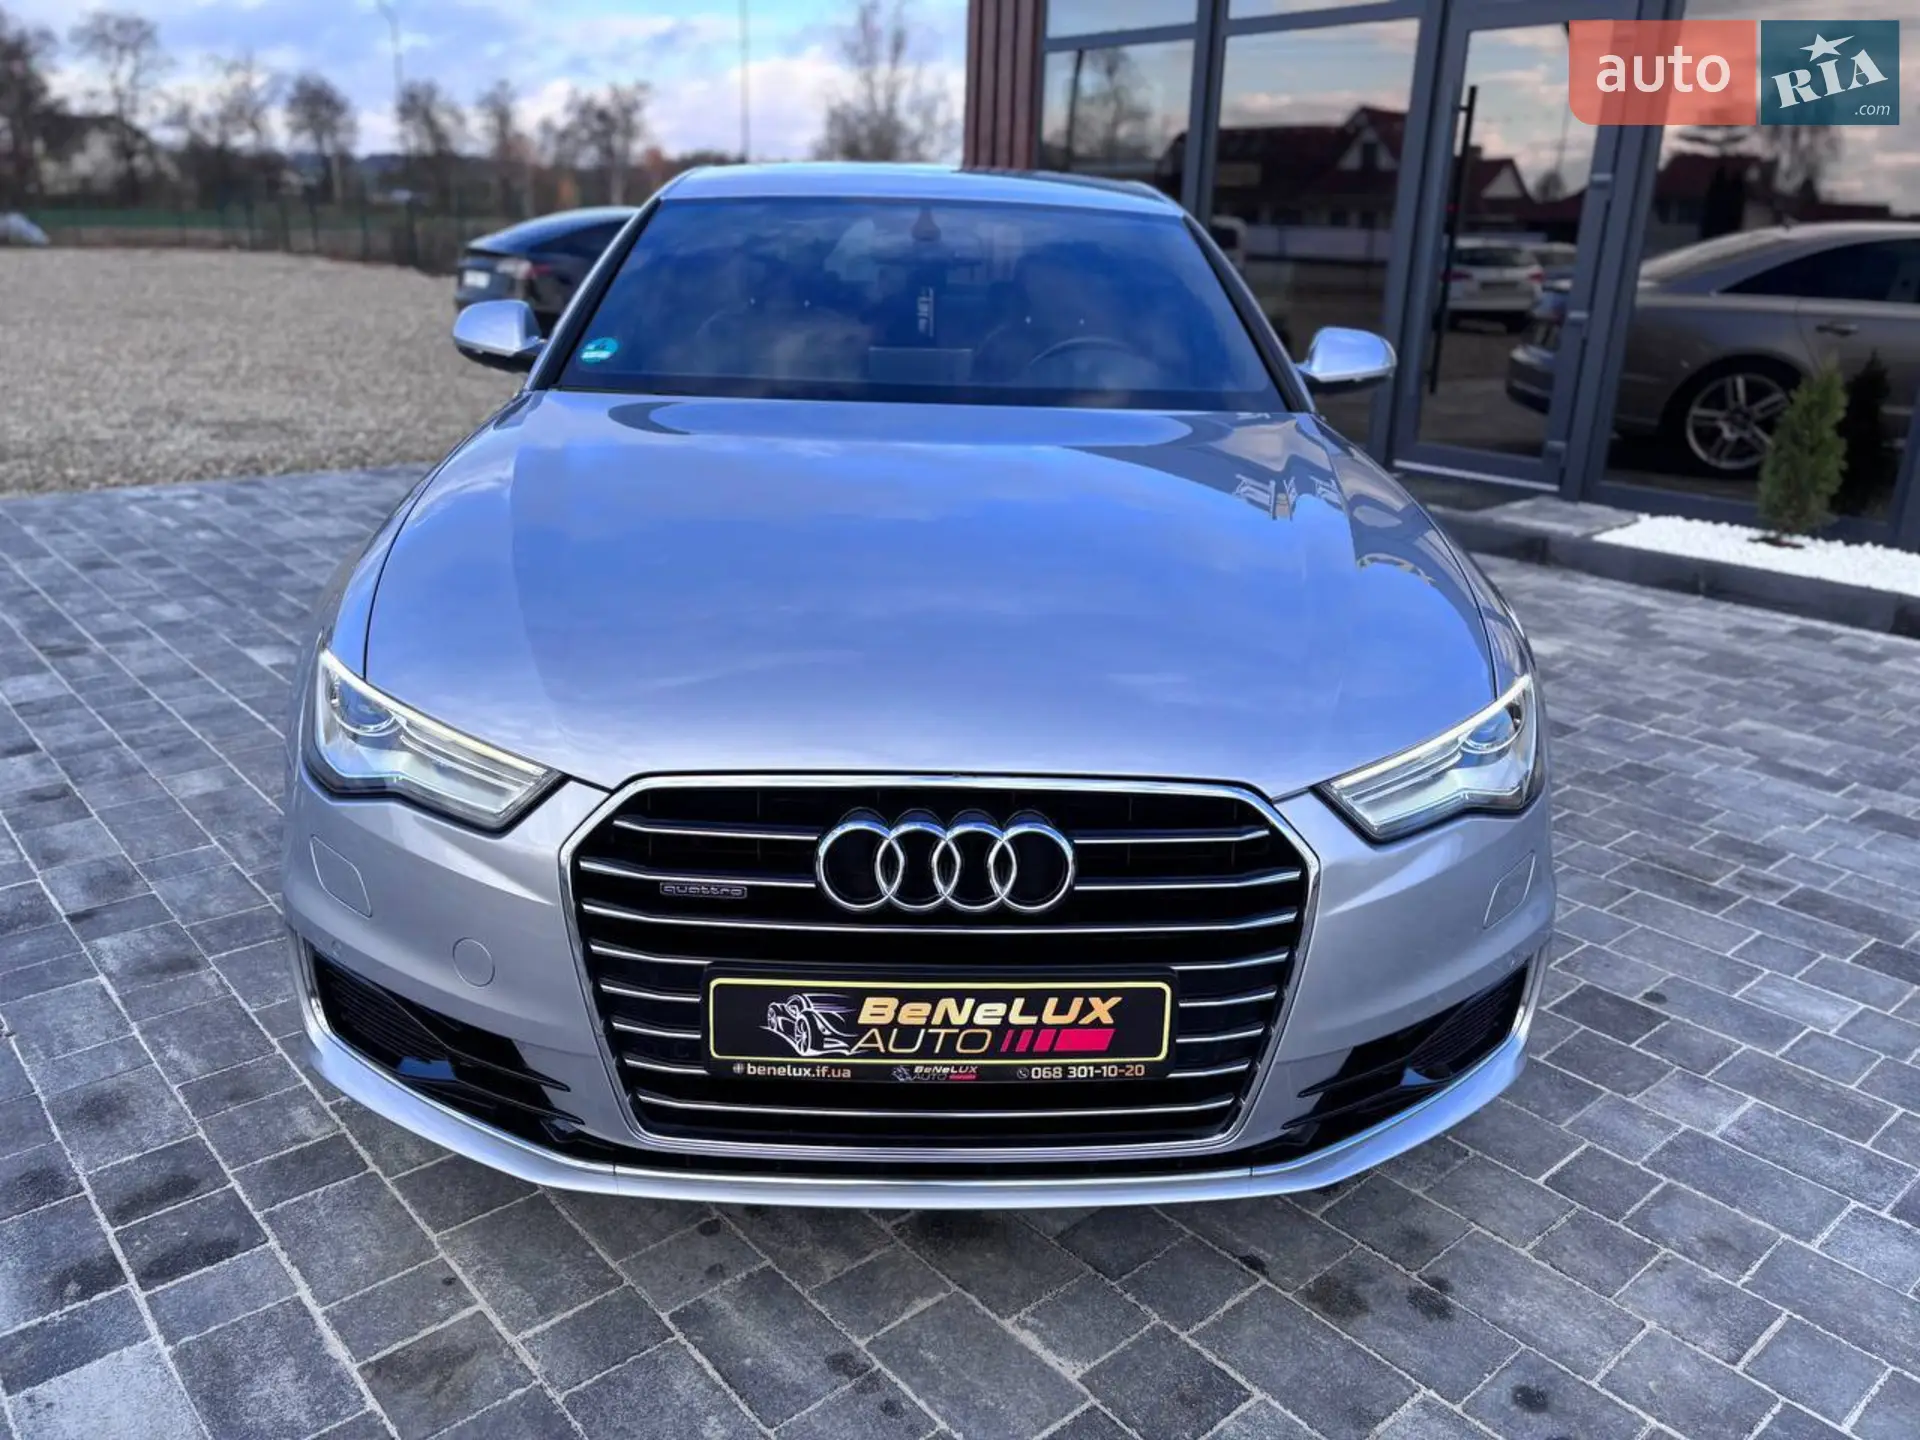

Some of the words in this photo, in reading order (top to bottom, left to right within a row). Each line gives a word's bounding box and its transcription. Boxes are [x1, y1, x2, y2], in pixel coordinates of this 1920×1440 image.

[663, 885, 743, 896] quattro
[857, 996, 1123, 1026] BeNeLUX
[850, 1028, 993, 1054] AUTO
[746, 1063, 852, 1078] benelux.if.ua
[1031, 1067, 1063, 1079] 068
[1067, 1064, 1146, 1078] 301-10-20
